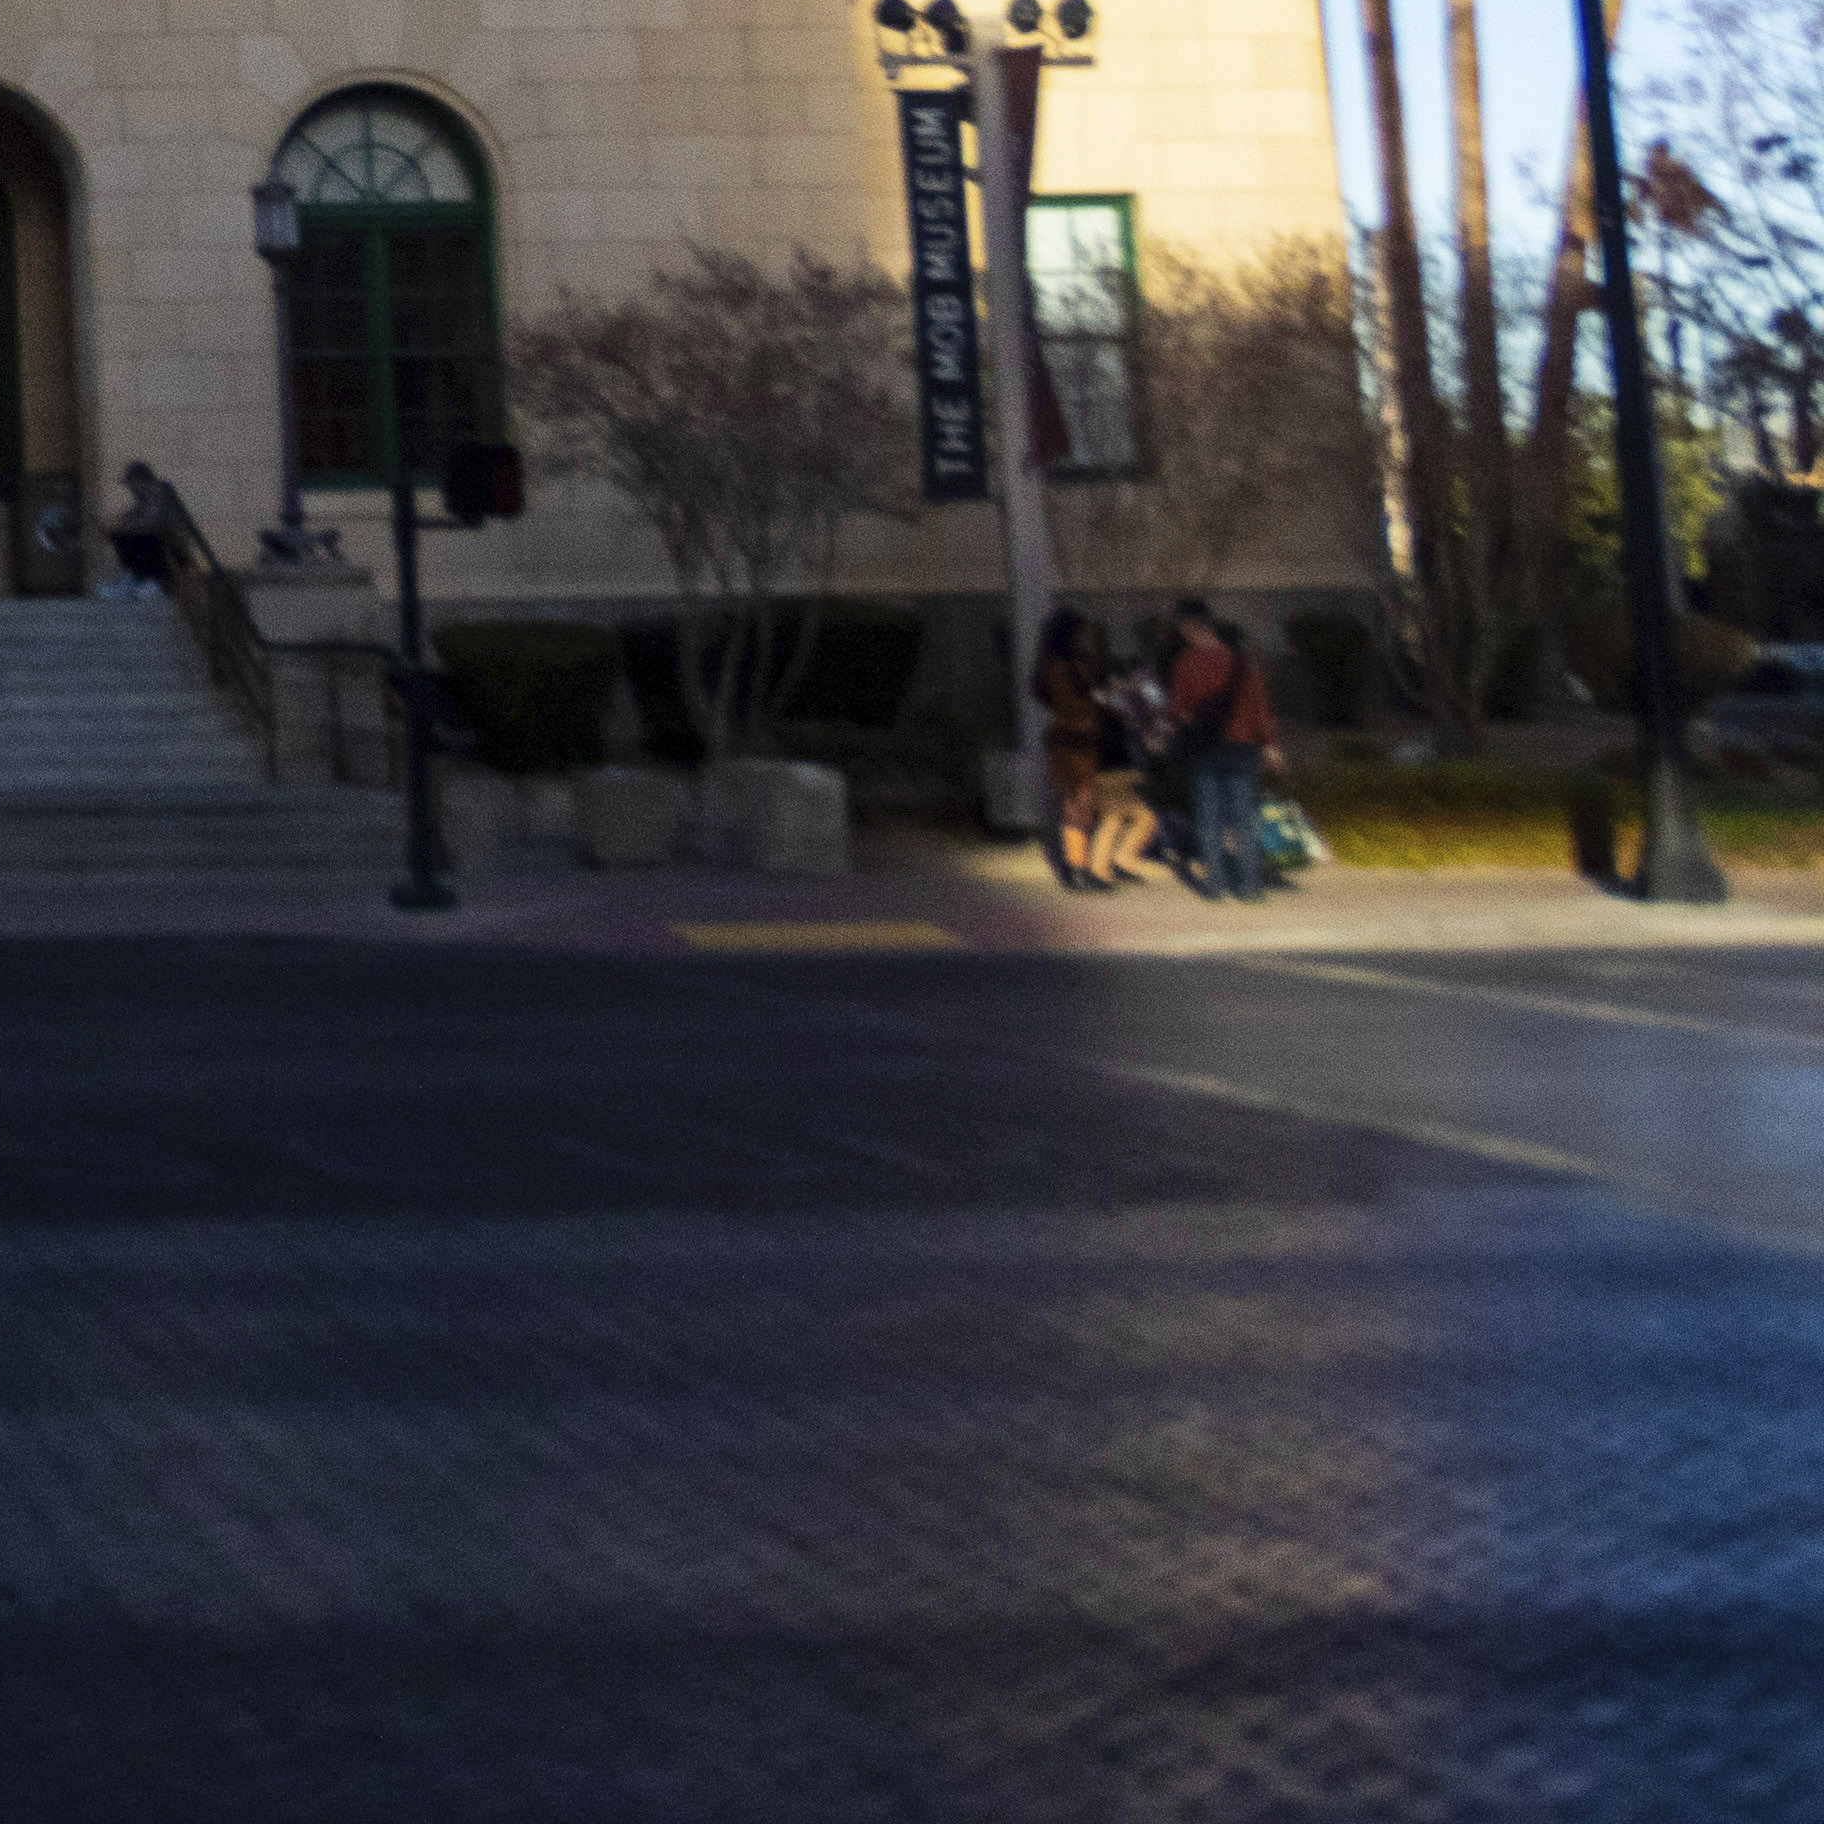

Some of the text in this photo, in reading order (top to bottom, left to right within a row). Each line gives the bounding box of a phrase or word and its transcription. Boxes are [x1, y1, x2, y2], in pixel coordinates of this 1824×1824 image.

[909, 106, 973, 473] THE MOB MUSEUM
